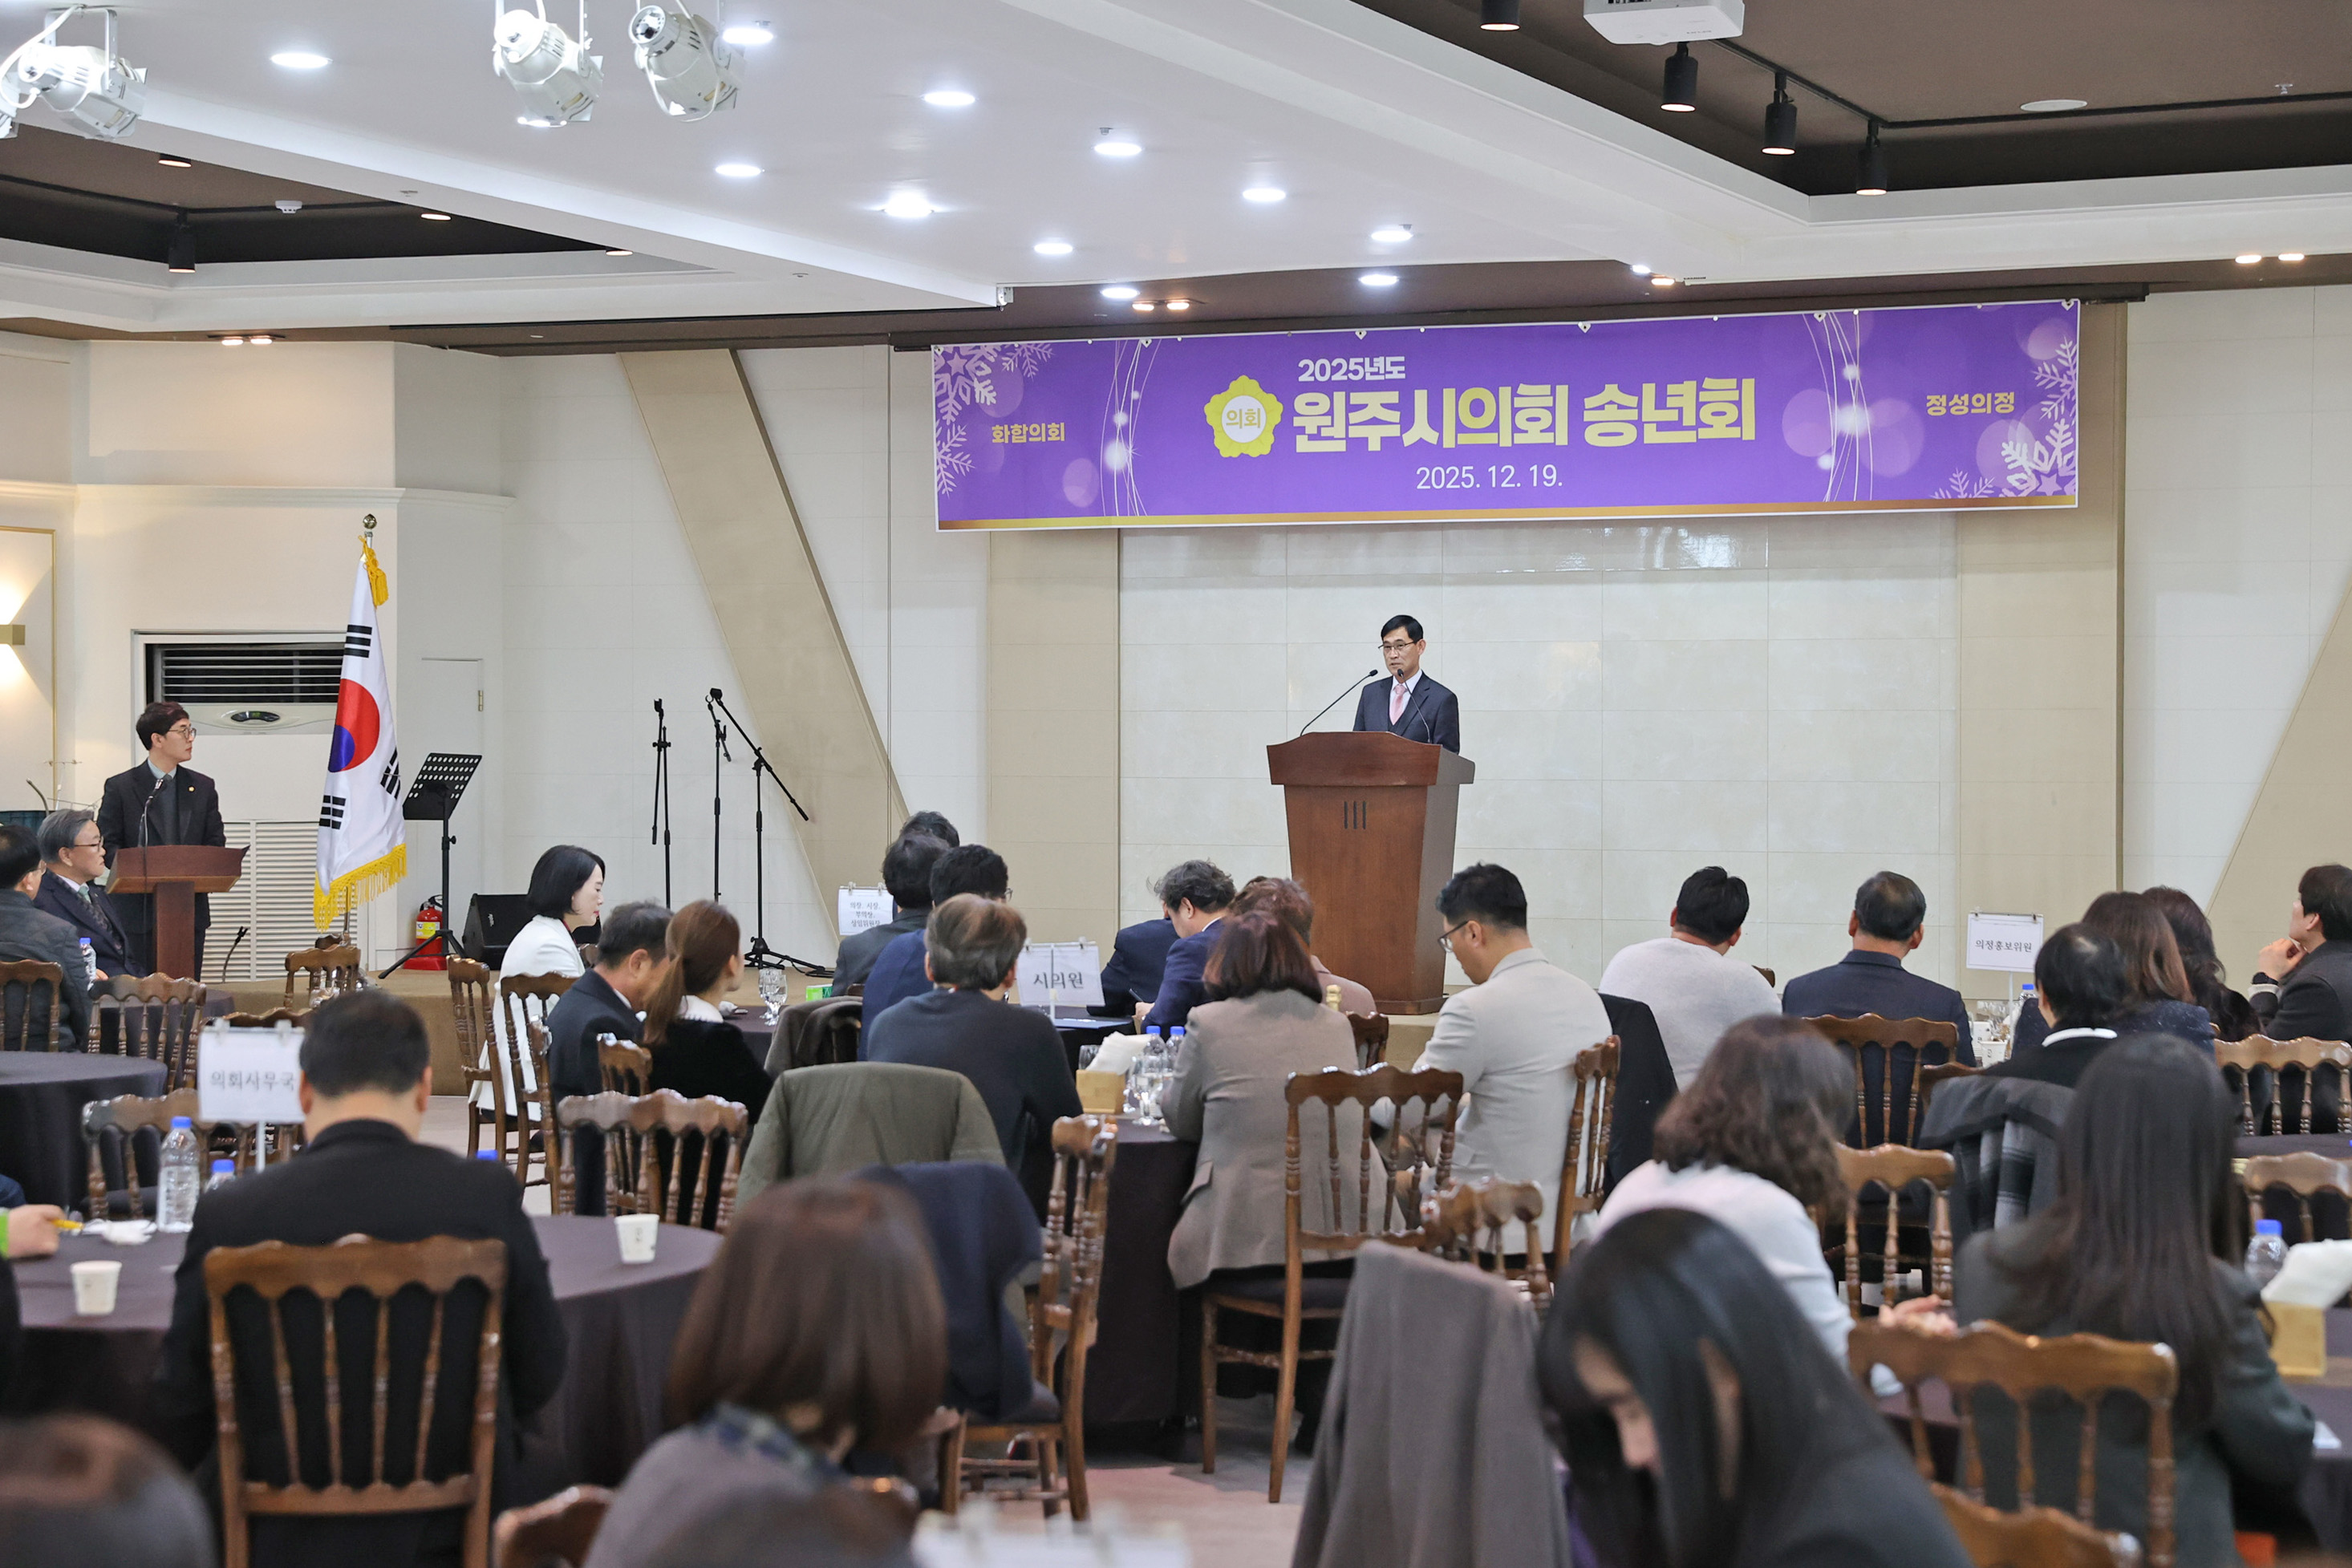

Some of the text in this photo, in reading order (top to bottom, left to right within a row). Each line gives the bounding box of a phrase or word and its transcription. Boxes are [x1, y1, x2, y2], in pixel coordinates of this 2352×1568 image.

[1298, 356, 1405, 381] 2025년도
[1926, 391, 2015, 415] 정성의정
[1226, 407, 1261, 429] 의회
[1293, 377, 1756, 453] 원주시의회 송년회
[991, 422, 1064, 444] 화합의회
[1416, 464, 1563, 489] 2025. 12. 19.
[1975, 939, 2032, 953] 의정홍보위원
[1033, 971, 1084, 989] 시의원
[210, 1070, 294, 1092] 의회사무국
